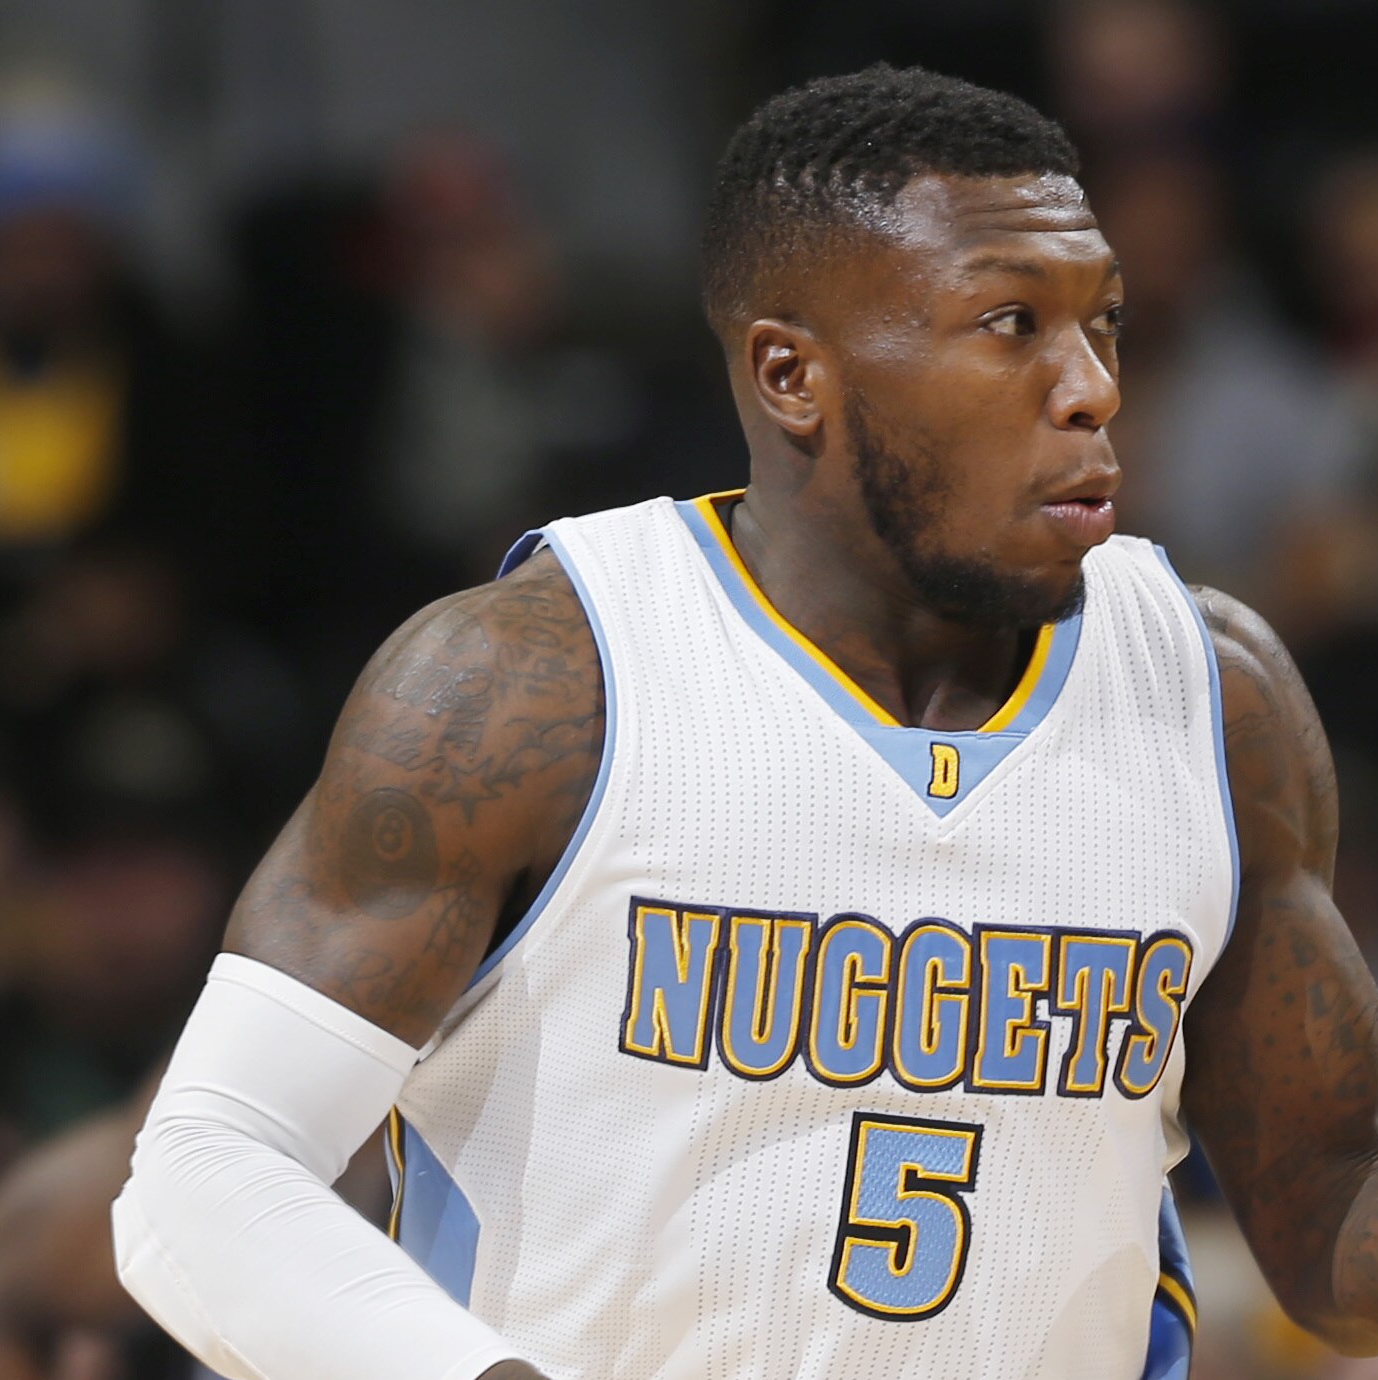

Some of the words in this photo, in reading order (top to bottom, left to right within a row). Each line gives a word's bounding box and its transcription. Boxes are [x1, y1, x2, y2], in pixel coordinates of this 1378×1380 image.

[927, 742, 961, 799] D
[619, 896, 1194, 1099] NUGGETS
[827, 1111, 984, 1322] 5
